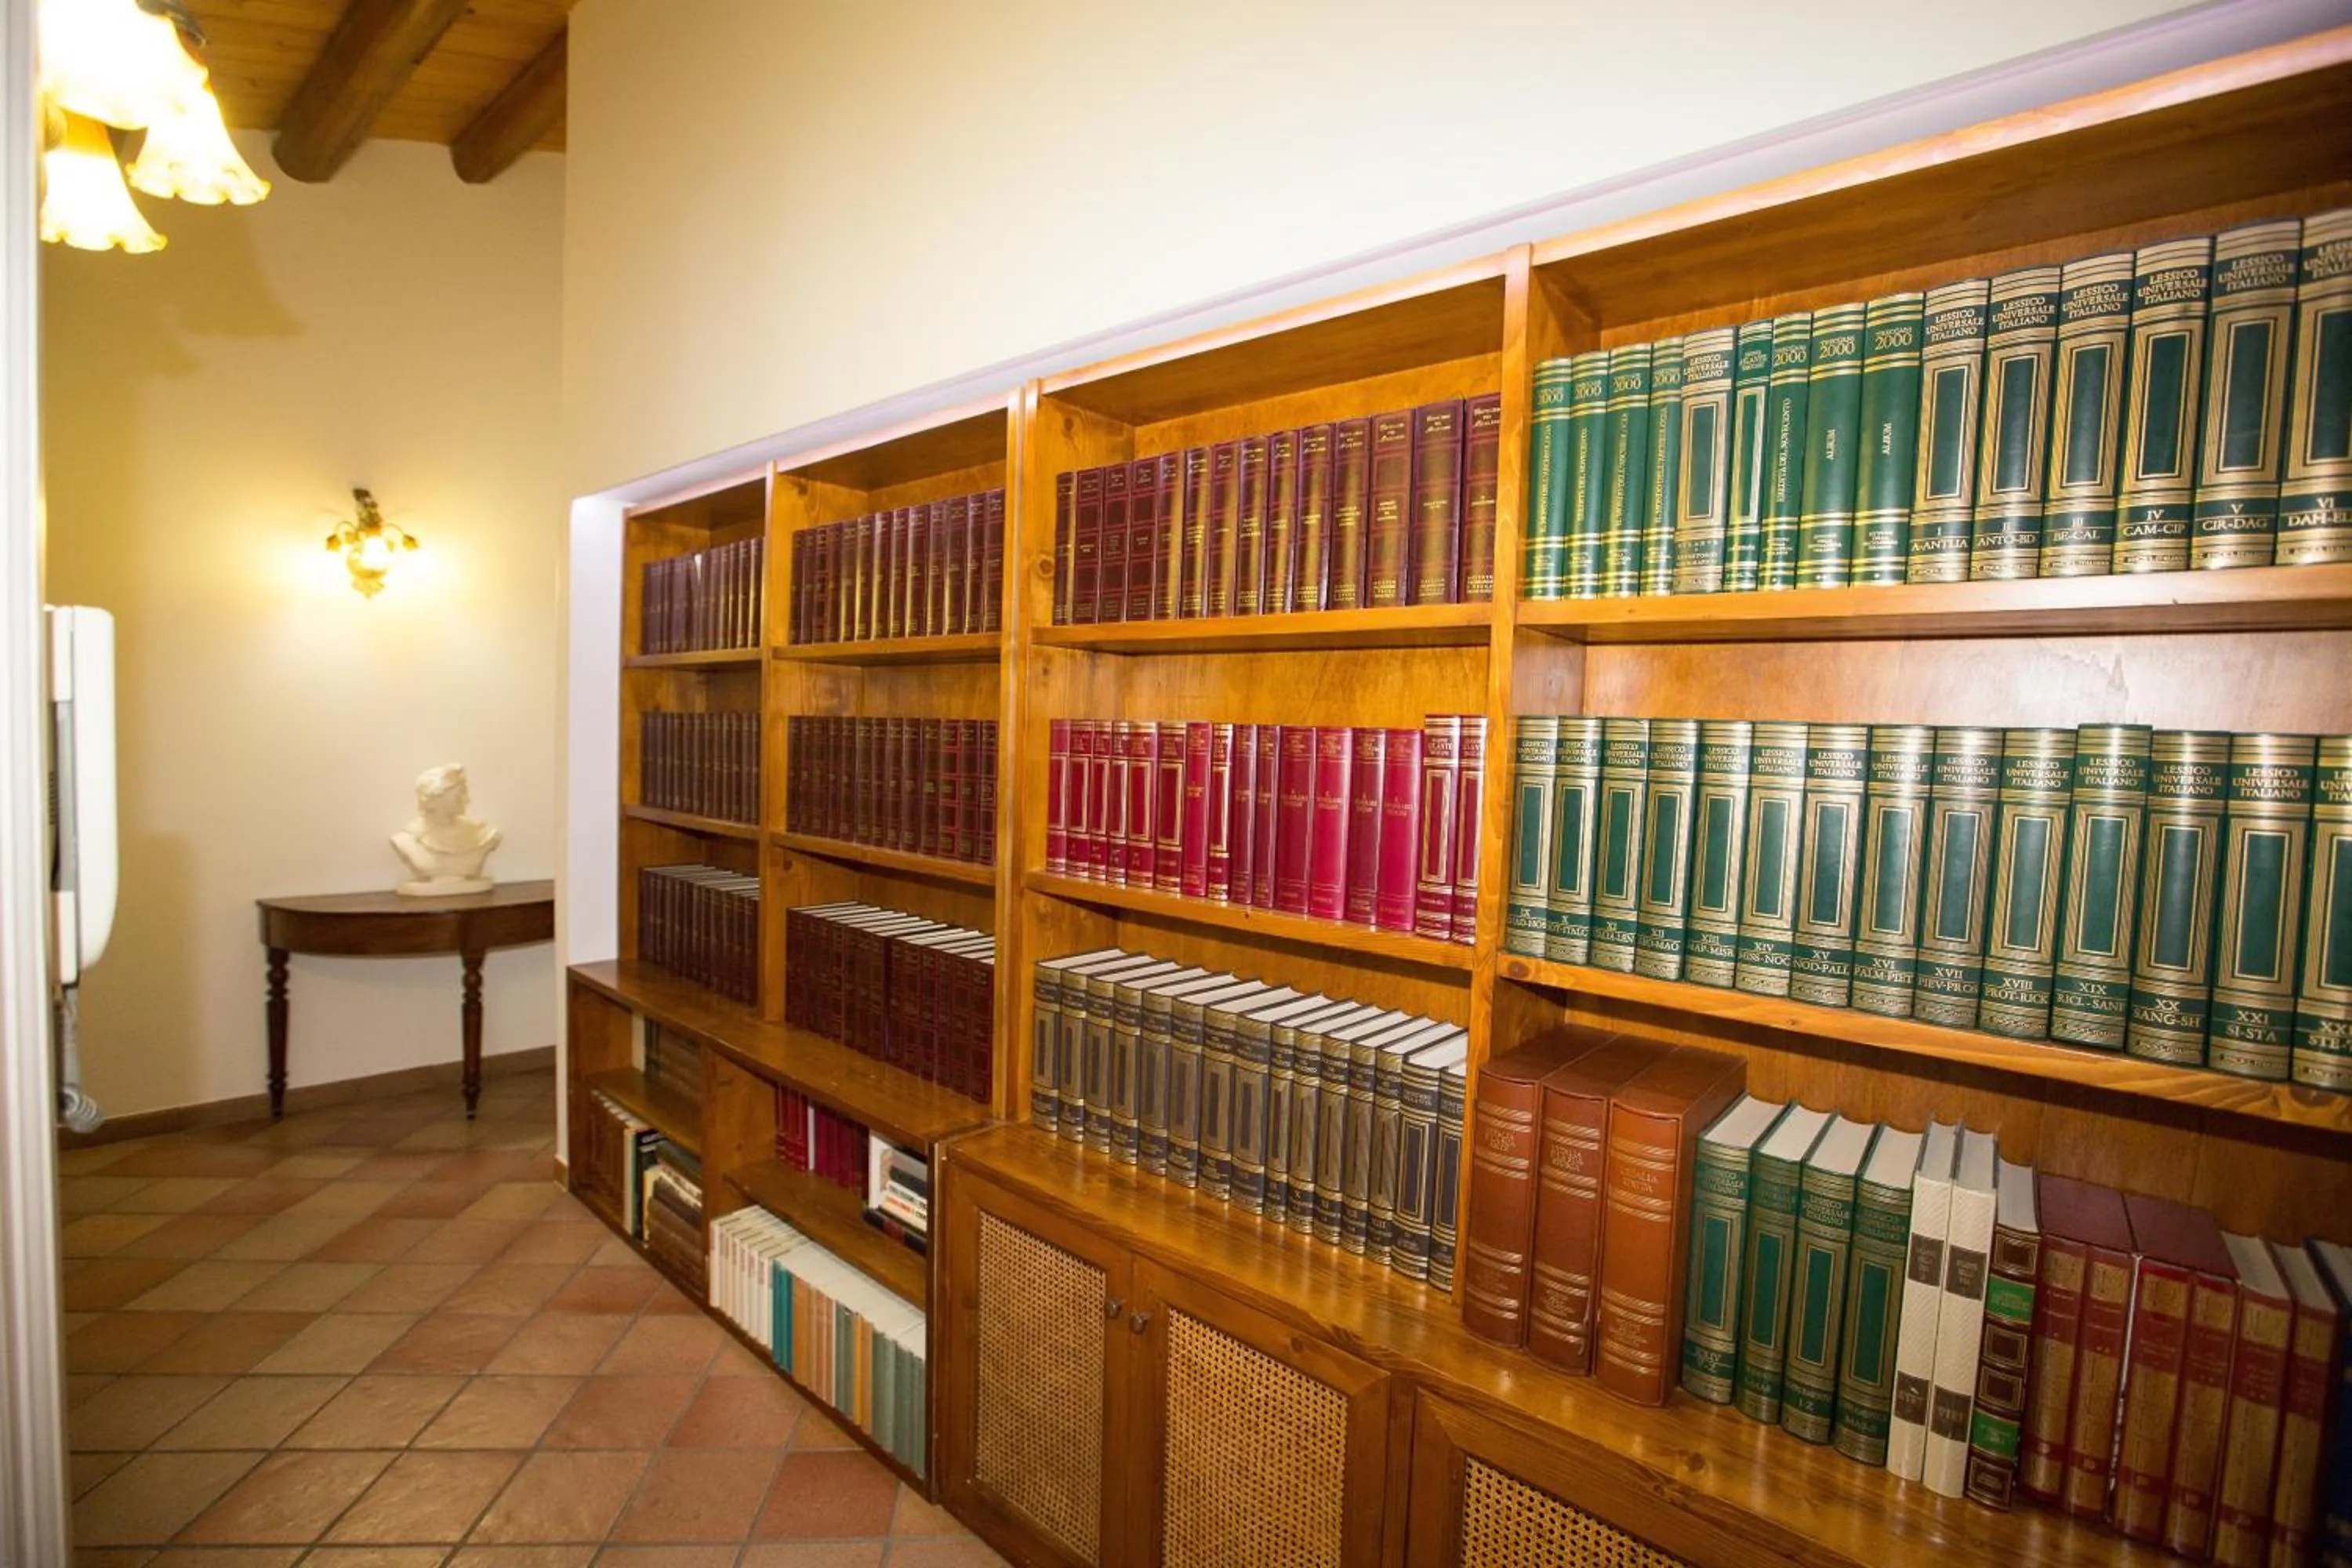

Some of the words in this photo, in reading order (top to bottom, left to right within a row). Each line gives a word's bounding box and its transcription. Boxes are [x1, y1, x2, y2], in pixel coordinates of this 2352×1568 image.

[2232, 253, 2284, 270] LESSICO
[2149, 269, 2198, 285] LESSICO
[2219, 263, 2294, 284] UNIVERSALE
[2138, 278, 2208, 298] UNIVERSALE
[2227, 274, 2287, 292] ITALIANO
[2074, 284, 2119, 299] LESSICO
[2144, 289, 2201, 305] ITALIANO
[2003, 296, 2045, 311] LESSICO
[2063, 292, 2129, 311] UNIVERSALE
[1935, 308, 1975, 324] LESSICO
[1992, 305, 2055, 323] UNIVERSALE
[2069, 303, 2121, 319] ITALIANO
[1926, 317, 1984, 335] UNIVERSALE
[1999, 315, 2048, 330] ITALIANO
[1931, 327, 1978, 341] ITALIANO
[1875, 332, 1912, 350] 2000
[1819, 340, 1855, 359] 2000
[1773, 350, 1806, 366] 2000
[2230, 504, 2244, 514] V
[2318, 496, 2334, 509] VI
[2147, 510, 2164, 521] IV
[2072, 517, 2083, 528] III
[2202, 517, 2268, 532] CIR-DAG
[2053, 528, 2101, 542] BE-CAL
[2123, 523, 2186, 537] CAM-CIP
[1818, 752, 1854, 760] LESSICO
[1947, 757, 1987, 766] LESSICO
[2089, 757, 2135, 768] LESSICO
[1809, 759, 1863, 769] UNIVERSALE
[1937, 765, 1998, 776] UNIVERSALE
[2016, 760, 2060, 770] LESSICO
[2164, 765, 2212, 775] LESSICO
[1813, 768, 1856, 777] ITALIANO
[2006, 768, 2070, 779] UNIVERSALE
[2079, 766, 2145, 778] UNIVERSALE
[2245, 768, 2298, 778] LESSICO
[1943, 774, 1990, 784] ITALIANO
[2012, 778, 2061, 788] ITALIANO
[2085, 776, 2137, 786] ITALIANO
[2154, 775, 2221, 786] UNIVERSALE
[2233, 777, 2309, 789] UNIVERSALE
[2158, 785, 2213, 794] ITALIANO
[2240, 788, 2300, 799] ITALIANO
[1561, 915, 1568, 924] X
[1754, 942, 1774, 953] XIV
[1813, 950, 1830, 960] XV
[1794, 959, 1849, 975] NOD-PALL
[1872, 958, 1895, 969] XVI
[1935, 967, 1963, 979] XVII
[2003, 978, 2033, 990] XVIII
[2079, 982, 2107, 995] XIX
[1985, 986, 2048, 1004] PROT-RICK
[2155, 999, 2180, 1011] XX
[2132, 1008, 2200, 1028] SANG-SH
[2237, 1010, 2268, 1024] XXI
[2226, 1025, 2277, 1042] SI-STA
[2308, 1035, 2352, 1050] STE-
